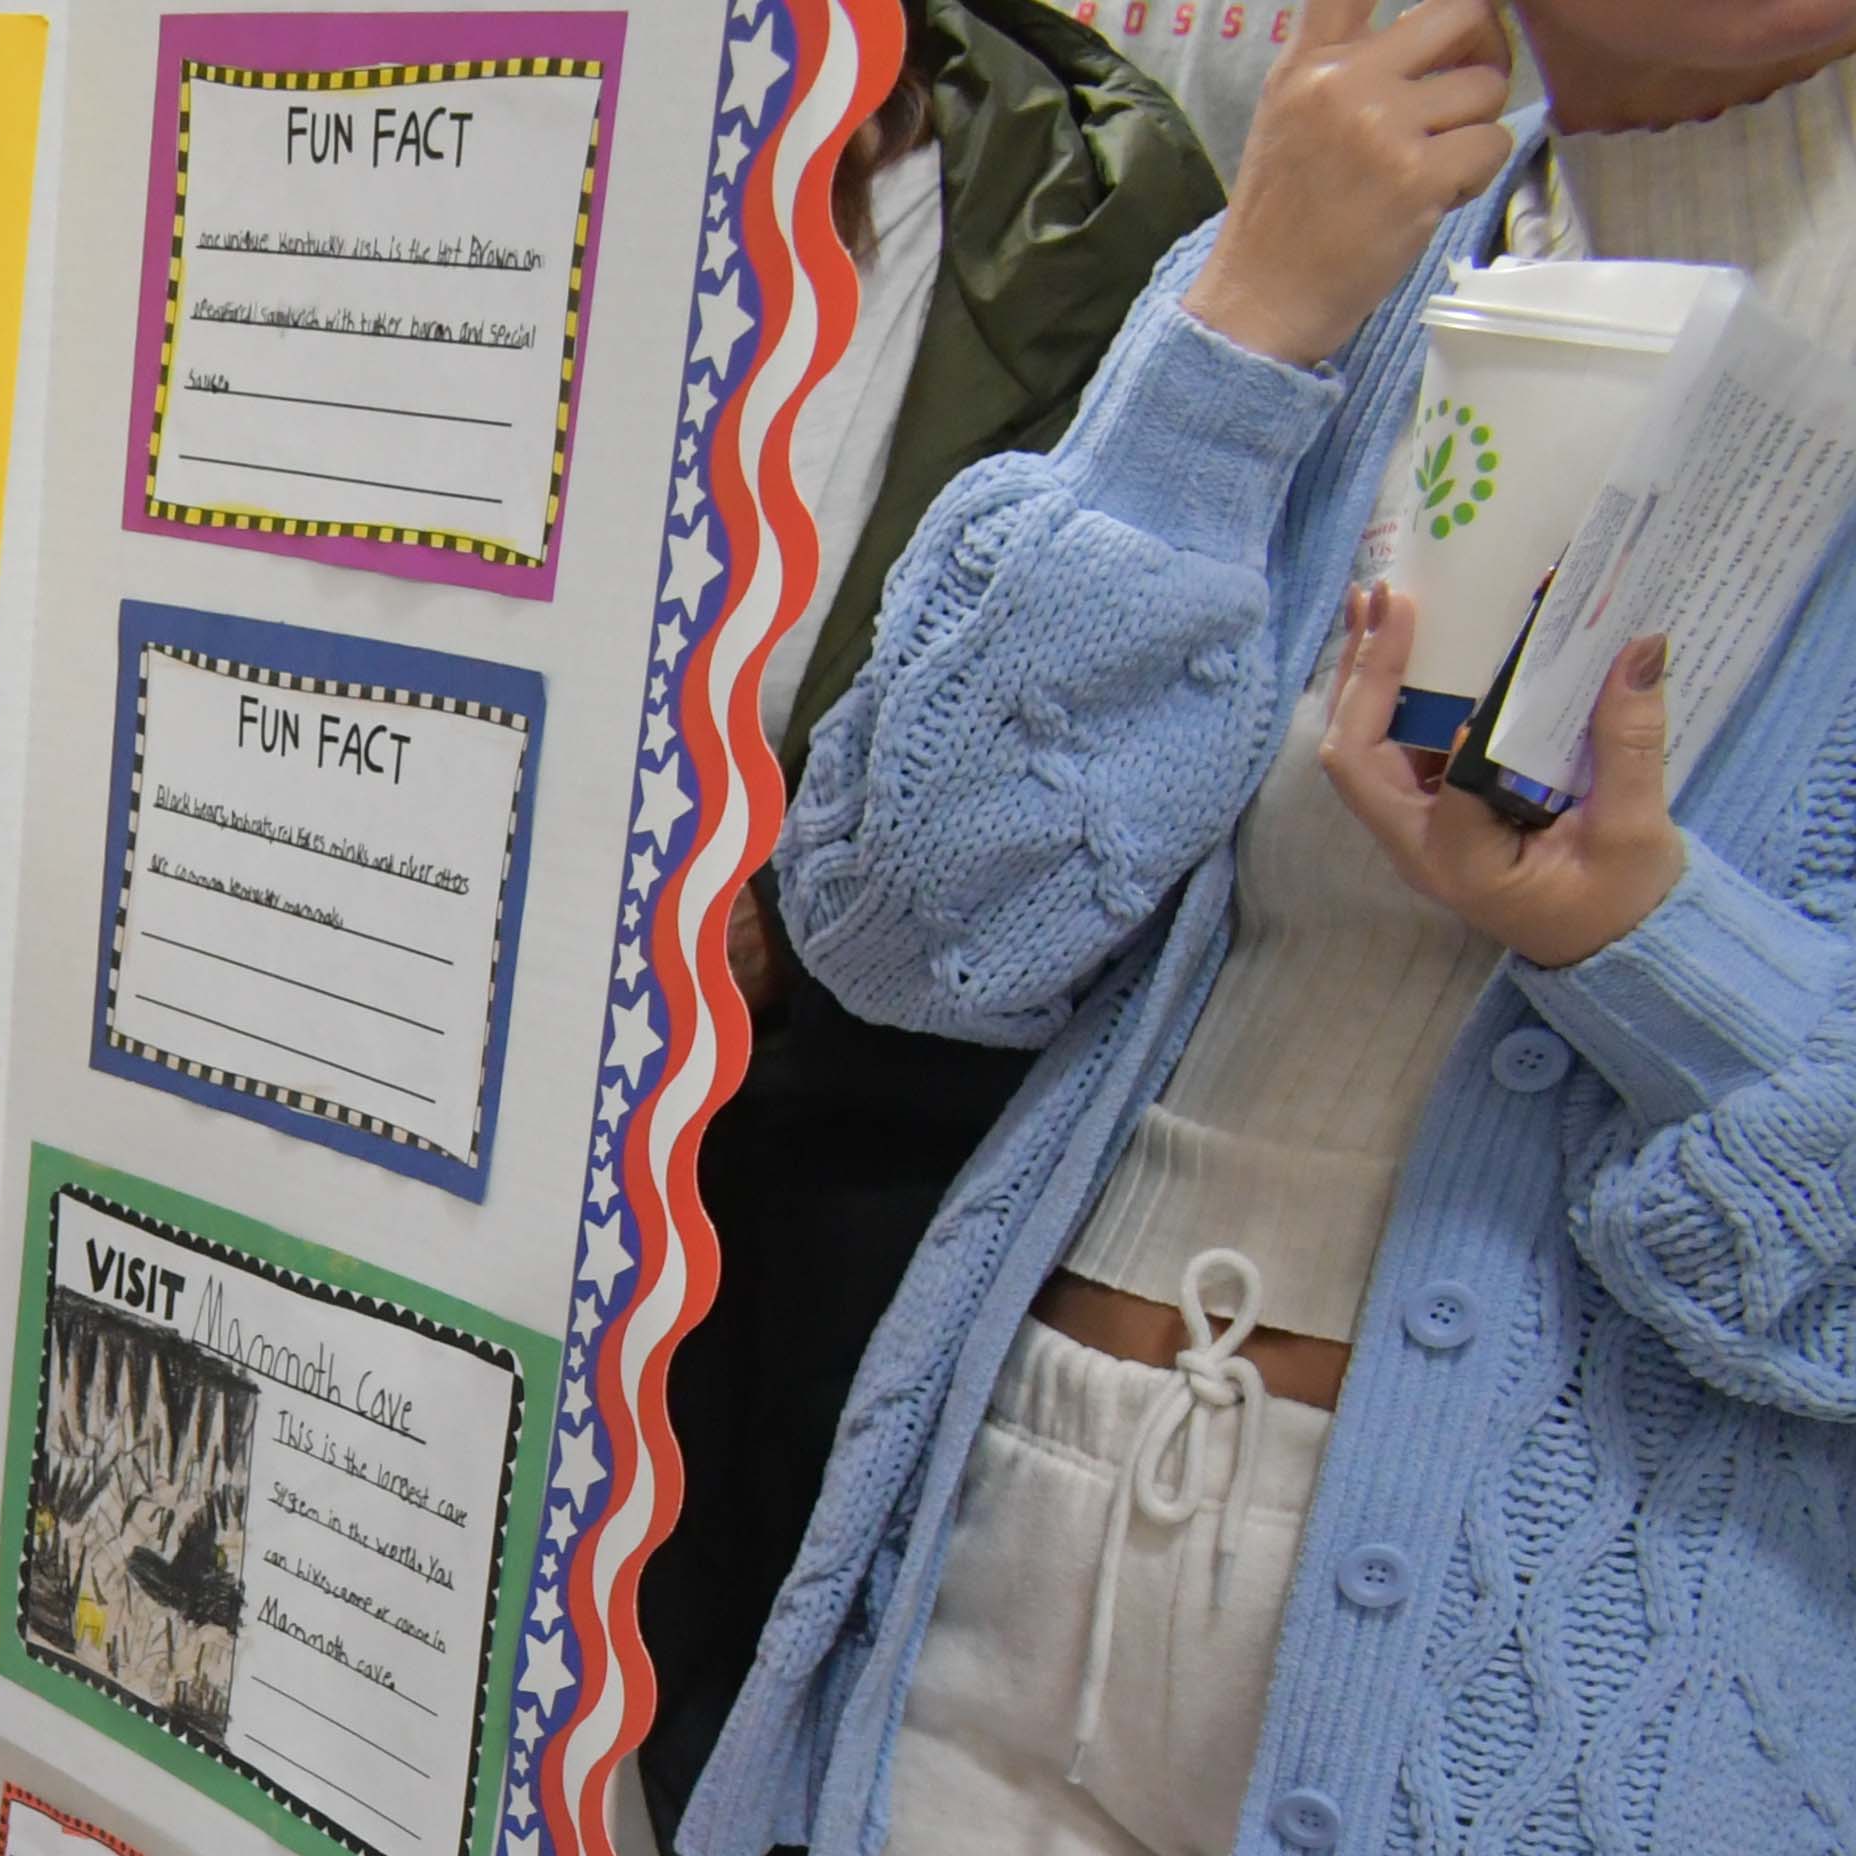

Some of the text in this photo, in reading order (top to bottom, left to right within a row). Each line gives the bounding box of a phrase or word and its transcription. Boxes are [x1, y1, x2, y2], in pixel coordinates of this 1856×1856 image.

[287, 106, 473, 168] FUN FACT
[389, 235, 401, 262] is
[238, 694, 411, 785] FUN FACT
[85, 1237, 186, 1321] VISIT
[190, 1274, 413, 1432] Mammoth Cave
[276, 1410, 314, 1452] This
[322, 1435, 337, 1465] is
[344, 1446, 368, 1480] the
[328, 1509, 341, 1533] in
[349, 1521, 377, 1549] the
[257, 1594, 350, 1667] Mammoth
